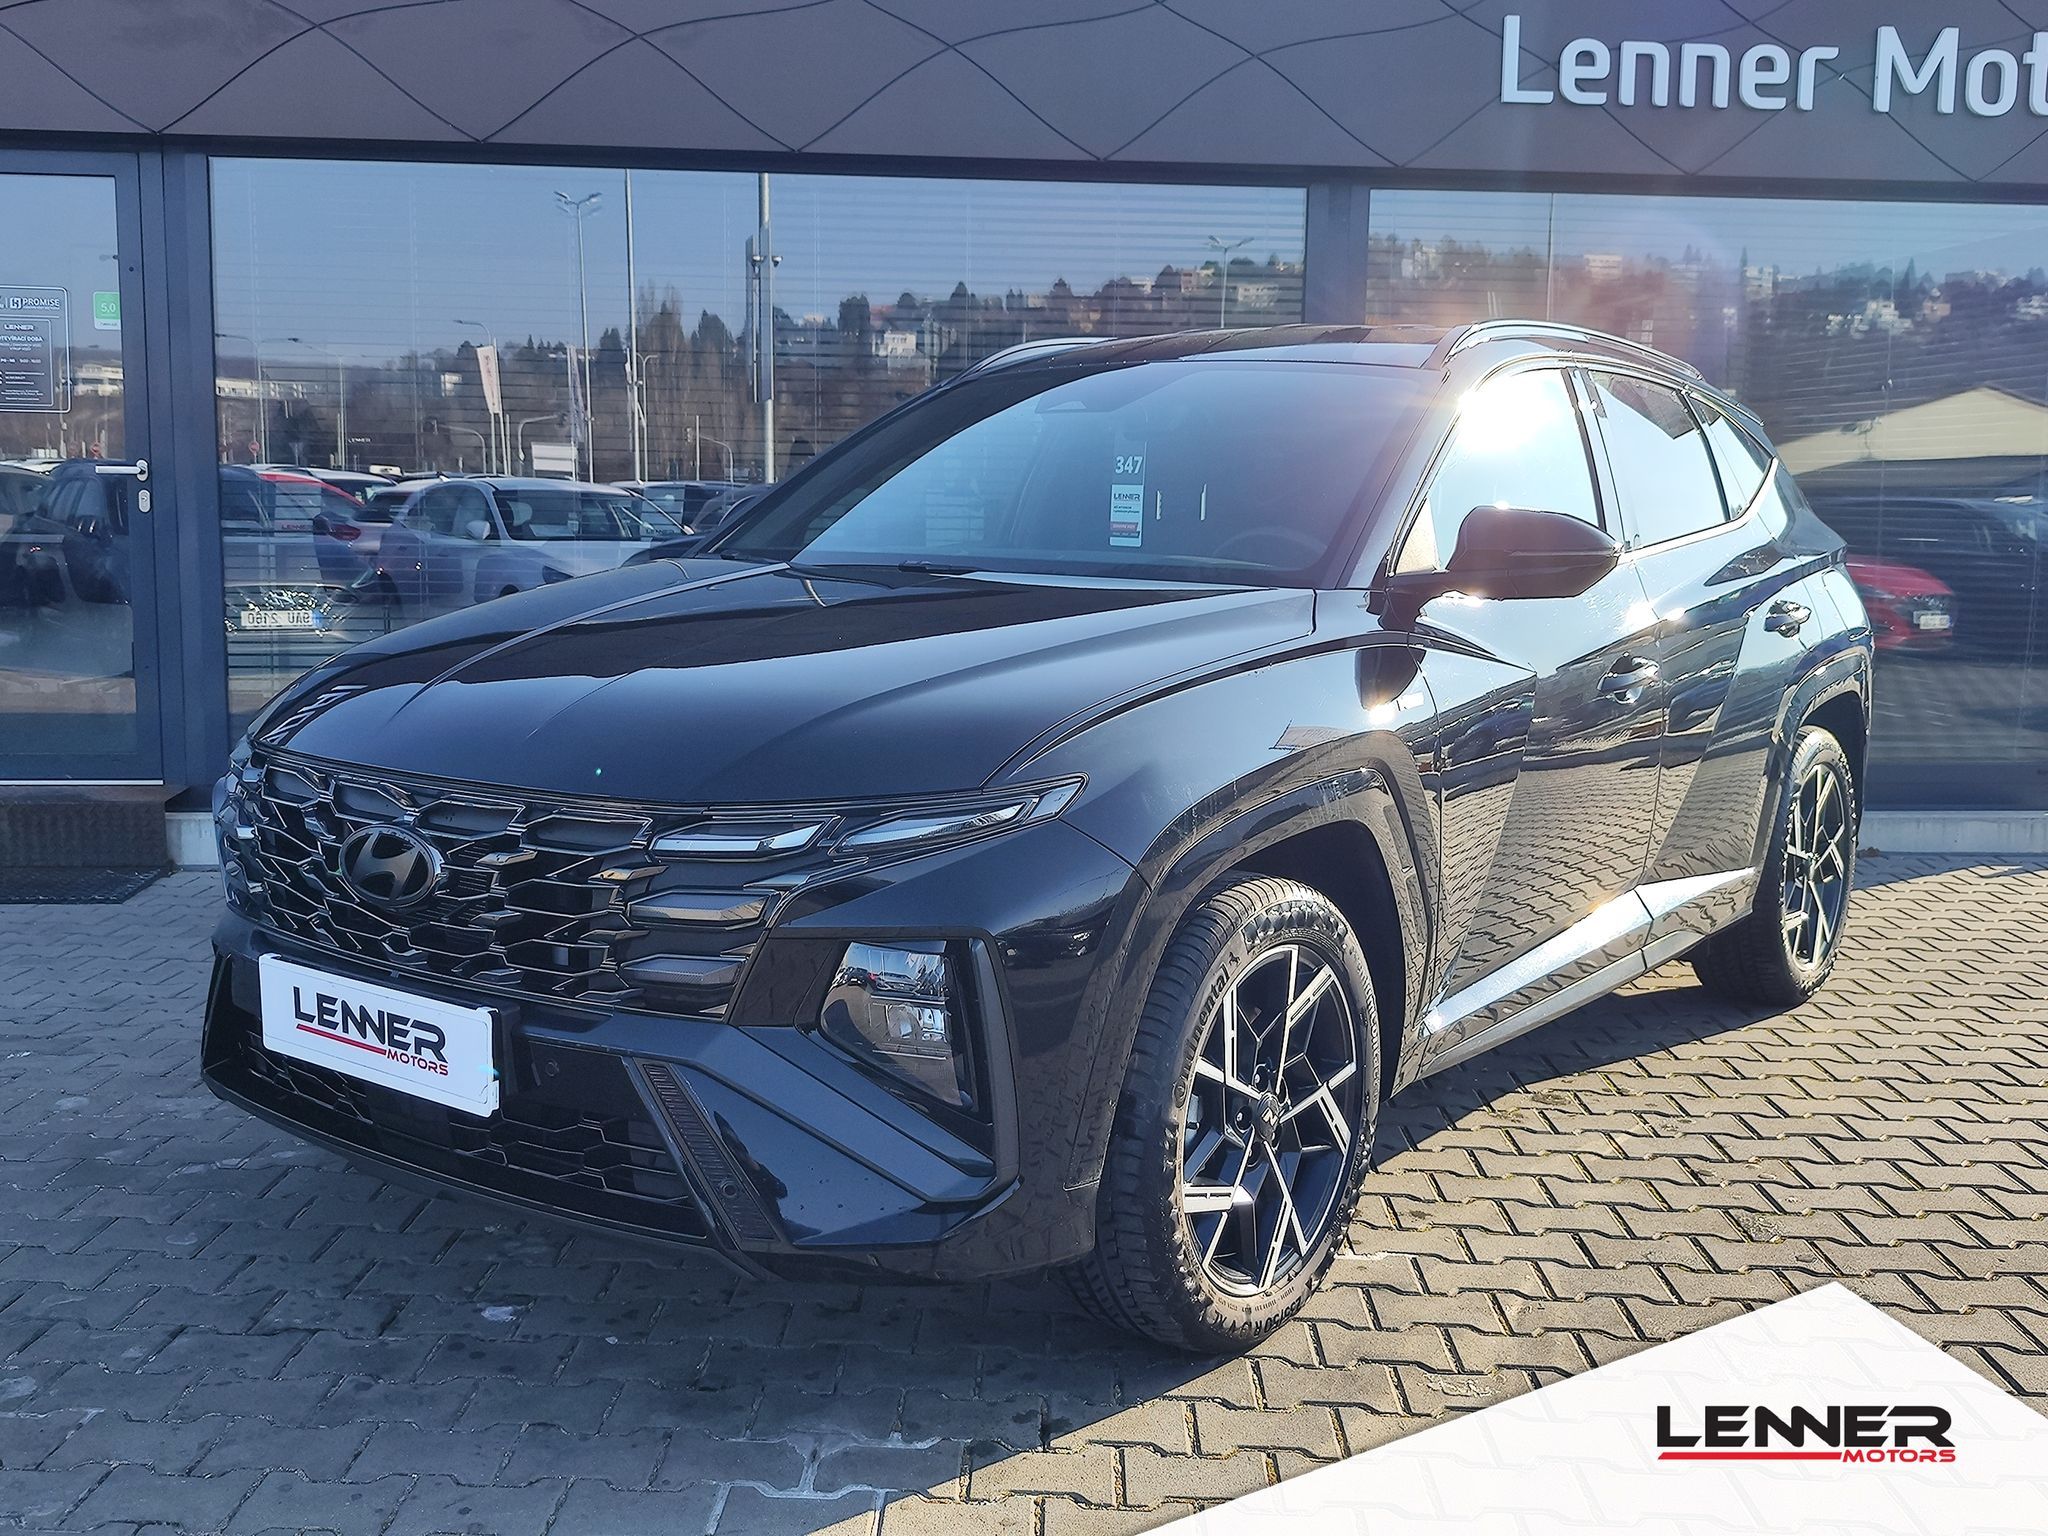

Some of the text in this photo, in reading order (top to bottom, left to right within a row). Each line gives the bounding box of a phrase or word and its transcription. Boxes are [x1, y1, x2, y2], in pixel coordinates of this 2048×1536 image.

[1501, 14, 1839, 111] Lenner
[23, 298, 60, 306] PROMISE
[101, 302, 116, 313] 5.0
[1115, 455, 1143, 474] 347
[293, 986, 448, 1064] LENNER
[387, 1049, 449, 1076] MOTORS
